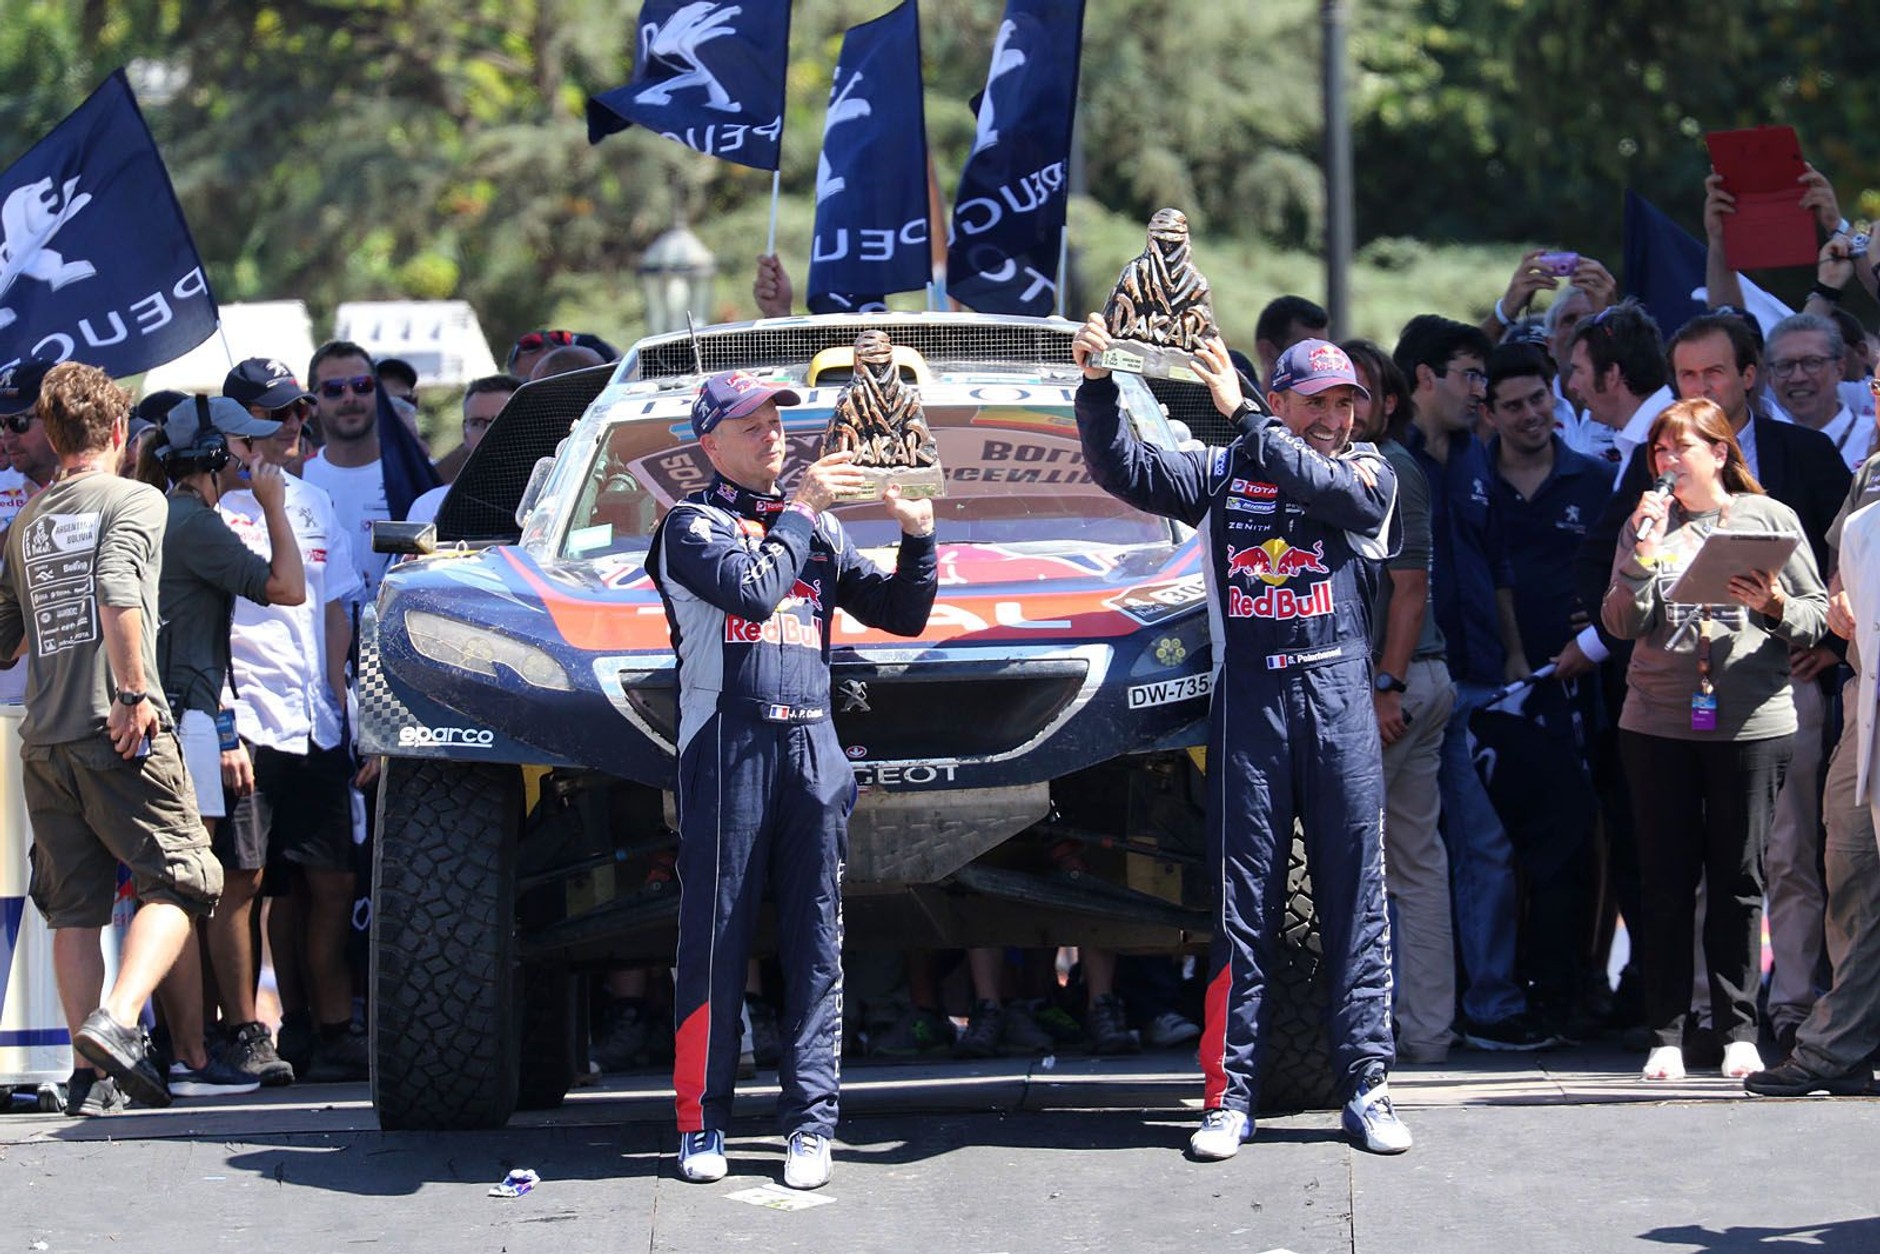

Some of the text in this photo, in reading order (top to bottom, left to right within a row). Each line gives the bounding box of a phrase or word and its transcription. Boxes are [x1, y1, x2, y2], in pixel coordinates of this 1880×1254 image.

[1111, 293, 1211, 350] DAKAR
[834, 421, 938, 467] DAKAR
[1228, 521, 1271, 532] ZENITH
[1228, 580, 1334, 620] Red Bull
[725, 613, 782, 644] Red
[852, 764, 959, 784] GEOT
